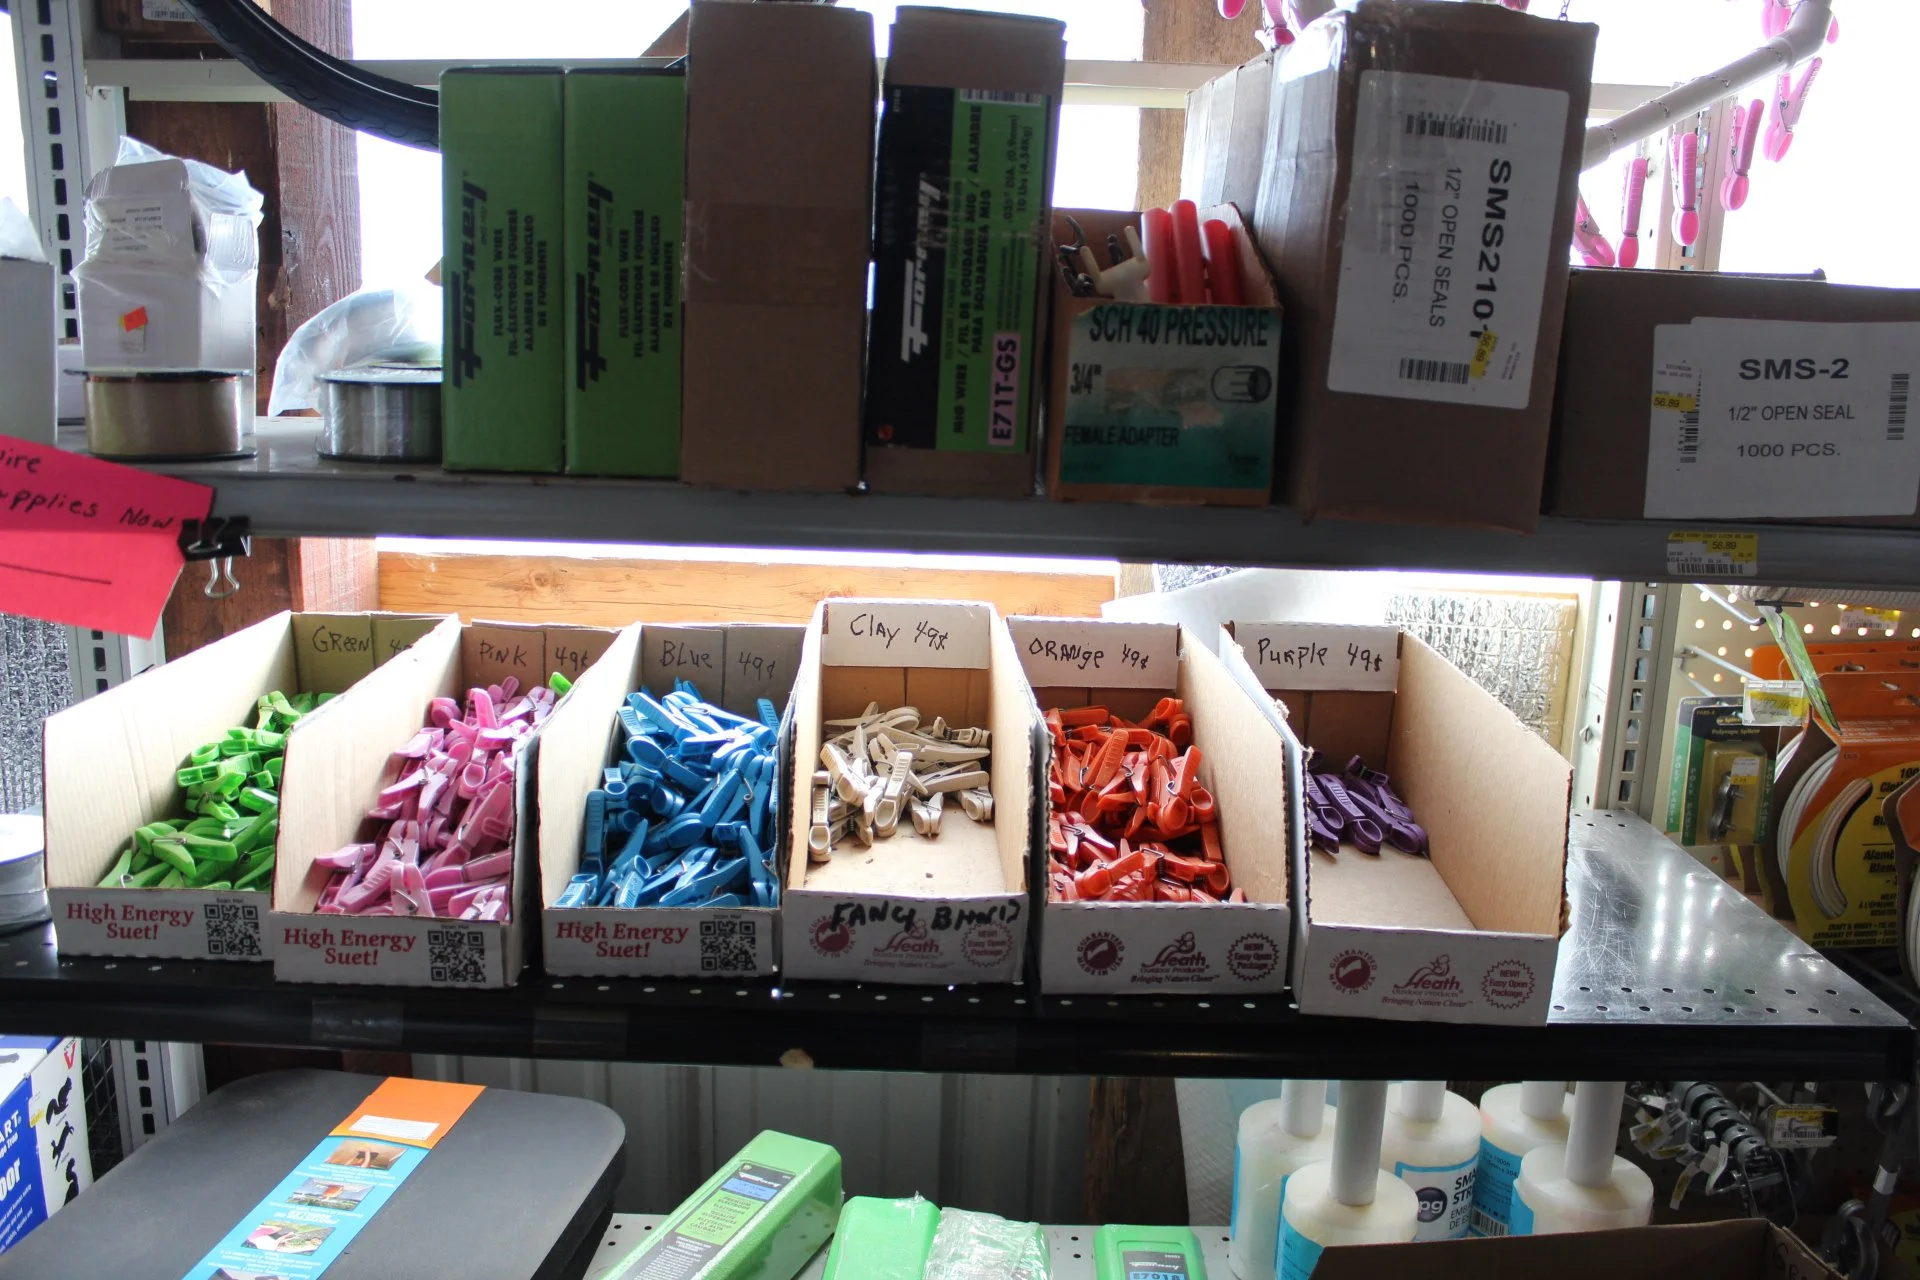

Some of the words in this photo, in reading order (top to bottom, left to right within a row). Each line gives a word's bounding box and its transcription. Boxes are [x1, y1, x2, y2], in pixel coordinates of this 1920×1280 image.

[967, 105, 982, 173] ALAMBRE
[1444, 166, 1462, 199] 1/2"
[964, 193, 977, 223] MIG
[1400, 182, 1421, 237] 1000
[1438, 205, 1459, 259] OPEN
[493, 229, 503, 261] WIRE
[618, 229, 629, 262] WIRE
[523, 270, 534, 286] DE
[649, 271, 660, 287] DE
[972, 316, 984, 353] PARA
[979, 189, 991, 219] MIG
[1392, 246, 1412, 303] PCS.
[451, 180, 487, 388] Forney
[576, 180, 612, 389] Forney
[1428, 265, 1451, 327] SEALS
[523, 291, 534, 351] ALAMBRE
[537, 311, 547, 326] DE
[649, 292, 660, 352] ALAMBRE
[663, 312, 673, 328] DE
[959, 302, 970, 319] DE
[1090, 304, 1133, 342] SCH
[1136, 307, 1160, 345] 40
[1164, 308, 1270, 347] PRESSURE
[955, 364, 967, 399] WIRE
[1738, 358, 1850, 380] SMS-2
[992, 339, 1018, 440] E71T-GS
[1728, 405, 1757, 421] 1/2"
[1761, 405, 1808, 421] OPEN
[1812, 404, 1855, 421] SEAL
[1065, 425, 1118, 446] FEMALE
[1119, 426, 1180, 447] ADAPTER
[1736, 443, 1784, 458] 1000
[1791, 442, 1842, 457] PCS.
[119, 506, 174, 529] Now
[67, 902, 116, 924] High
[122, 904, 194, 927] Energy
[830, 901, 917, 932] FANCY
[107, 922, 159, 940] Suet!
[283, 928, 335, 949] High
[341, 929, 416, 952] Energy
[556, 921, 607, 942] High
[612, 923, 689, 944] Energy
[324, 947, 379, 966] Suet!
[596, 941, 651, 958] Suet!
[1489, 980, 1507, 989] Easy
[1508, 980, 1528, 988] Open
[1499, 969, 1520, 978] NEW!
[1490, 989, 1523, 998] Package
